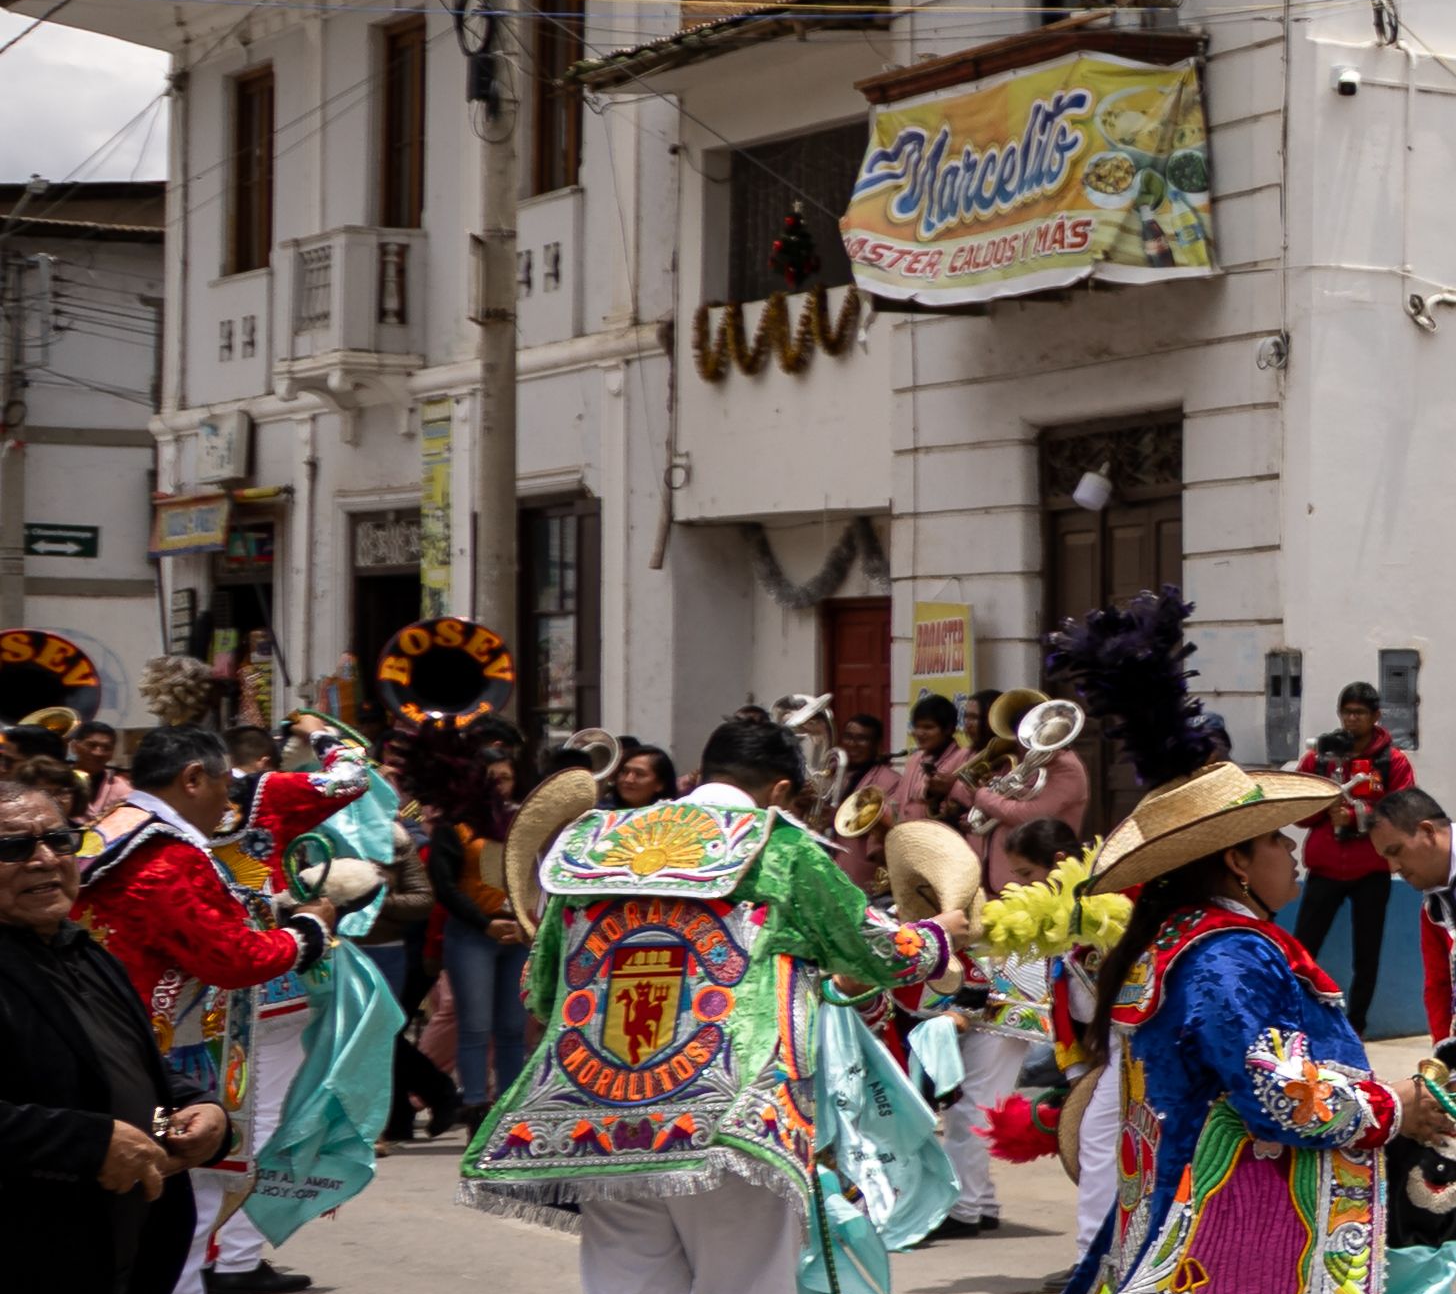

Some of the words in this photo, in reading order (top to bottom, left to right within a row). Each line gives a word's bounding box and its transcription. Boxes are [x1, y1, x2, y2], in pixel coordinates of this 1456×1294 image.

[853, 90, 1091, 235] Marcelito
[946, 231, 1019, 275] CALDOS
[1034, 214, 1093, 257] MÁS
[584, 900, 726, 960] MORALES
[563, 1041, 712, 1101] MORALITOS
[868, 1079, 893, 1119] ANDES
